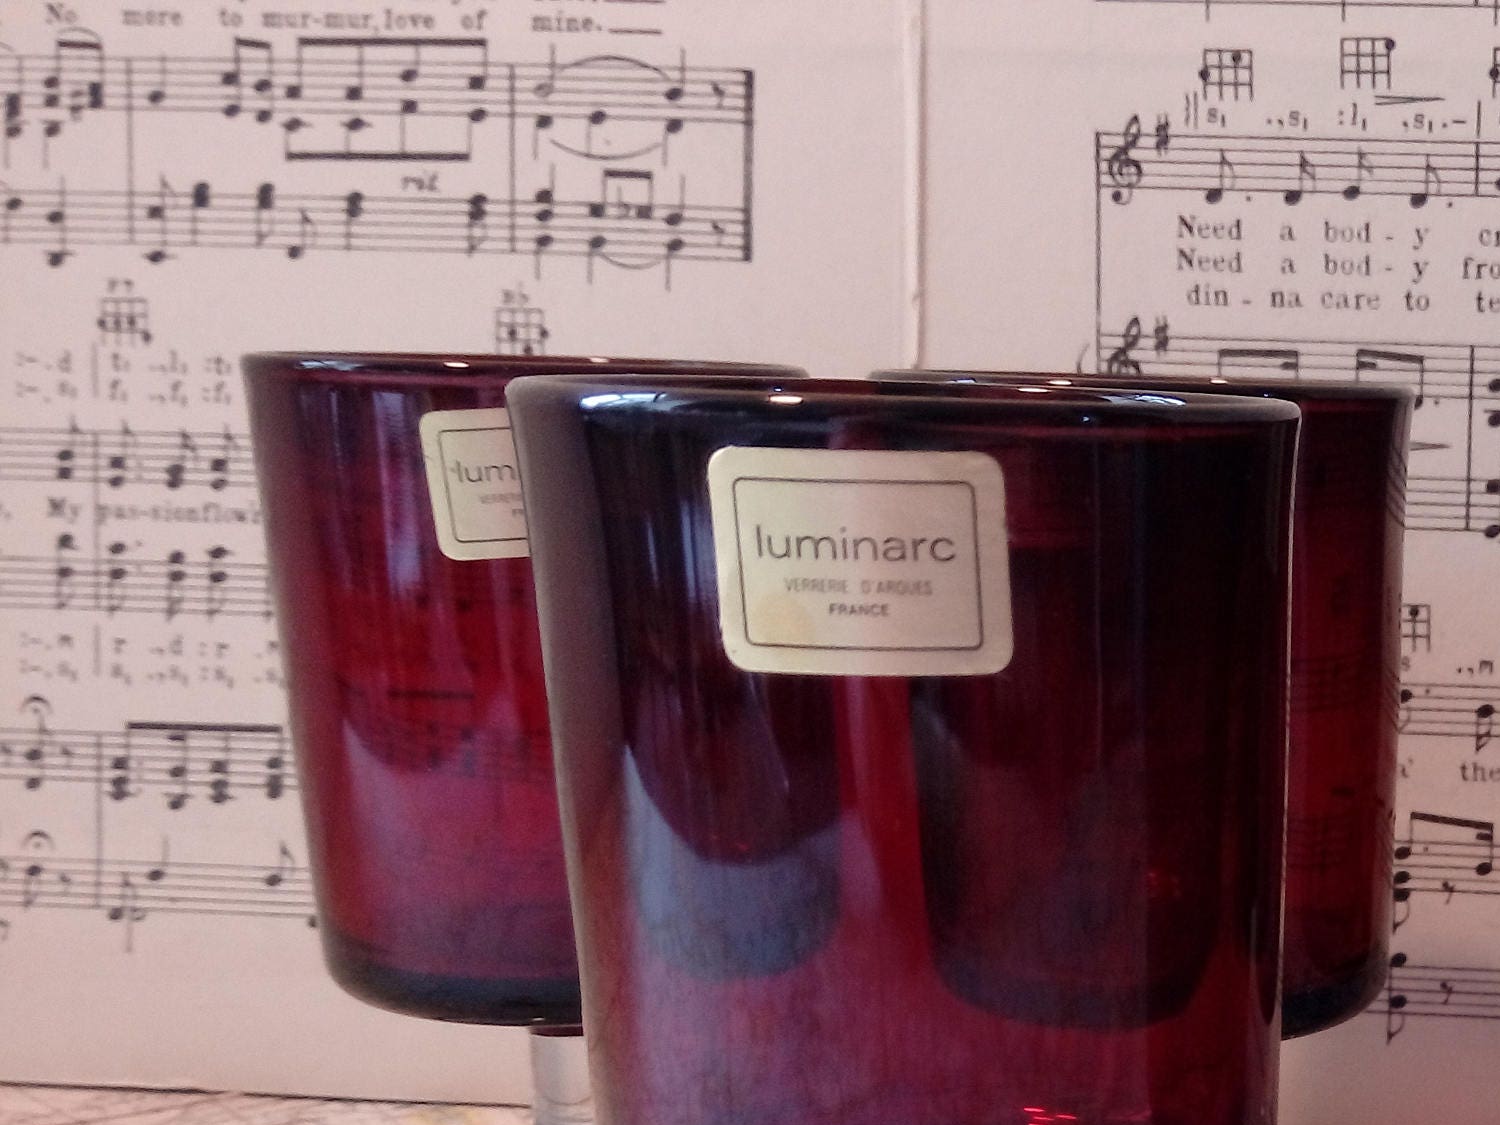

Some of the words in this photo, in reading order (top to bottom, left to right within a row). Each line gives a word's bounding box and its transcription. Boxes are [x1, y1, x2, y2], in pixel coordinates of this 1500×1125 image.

[220, 9, 243, 27] to
[1177, 214, 1243, 241] Need
[1279, 224, 1296, 242] a
[1176, 248, 1243, 273] Need
[1281, 257, 1296, 275] a
[1321, 291, 1381, 312] care
[1405, 290, 1430, 312] to
[754, 524, 958, 563] luminarc
[829, 603, 890, 618] FRANCE
